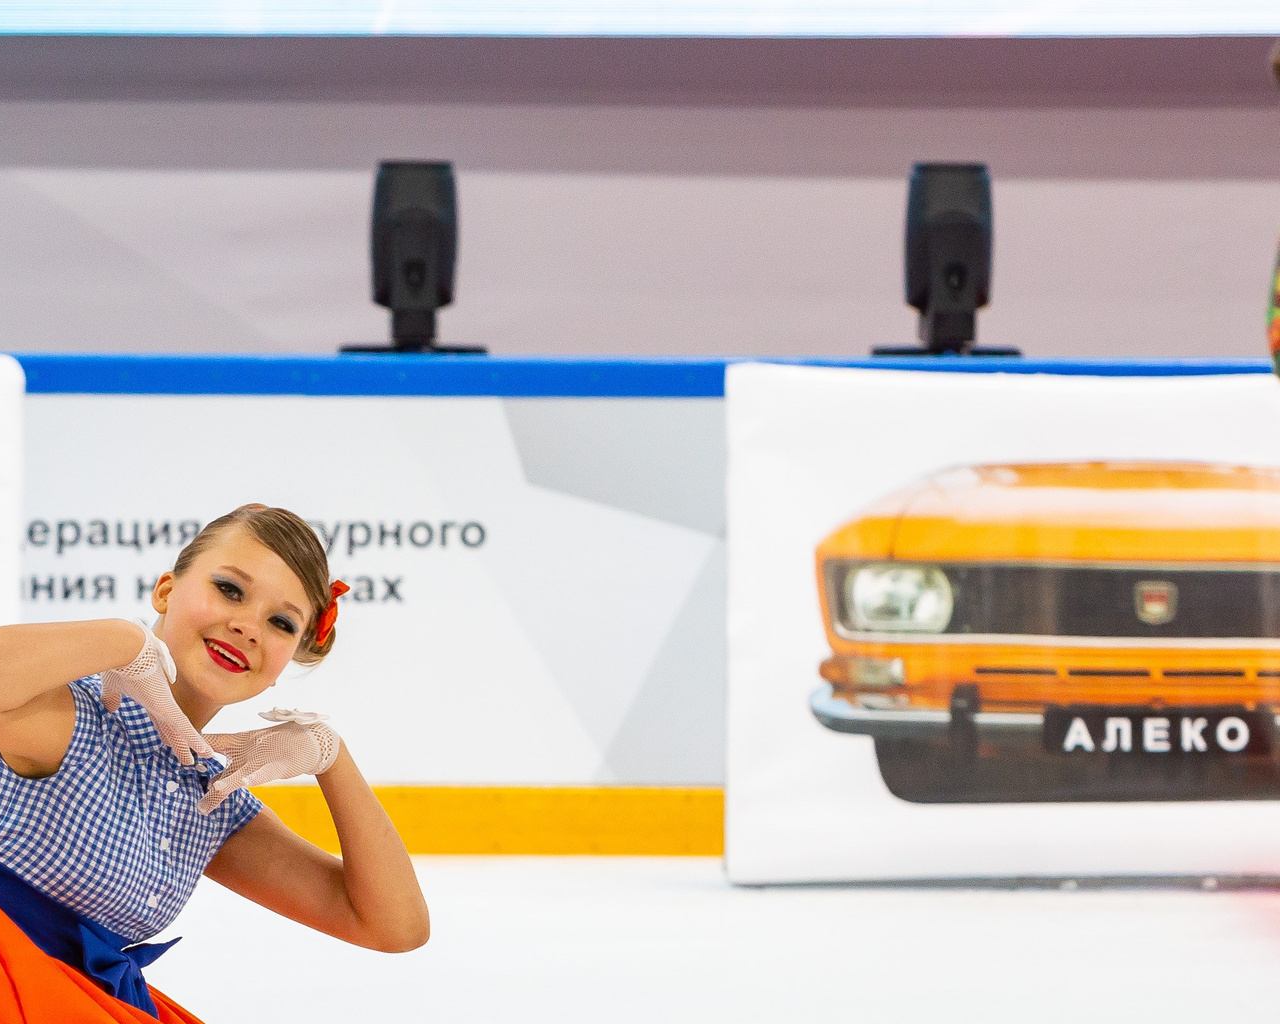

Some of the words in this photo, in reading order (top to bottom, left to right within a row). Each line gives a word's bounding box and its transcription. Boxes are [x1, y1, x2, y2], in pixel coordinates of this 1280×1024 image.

[20, 518, 202, 556] ерация
[308, 519, 487, 558] урного
[21, 574, 117, 601] ния
[1062, 716, 1250, 752] АЛЕКО
